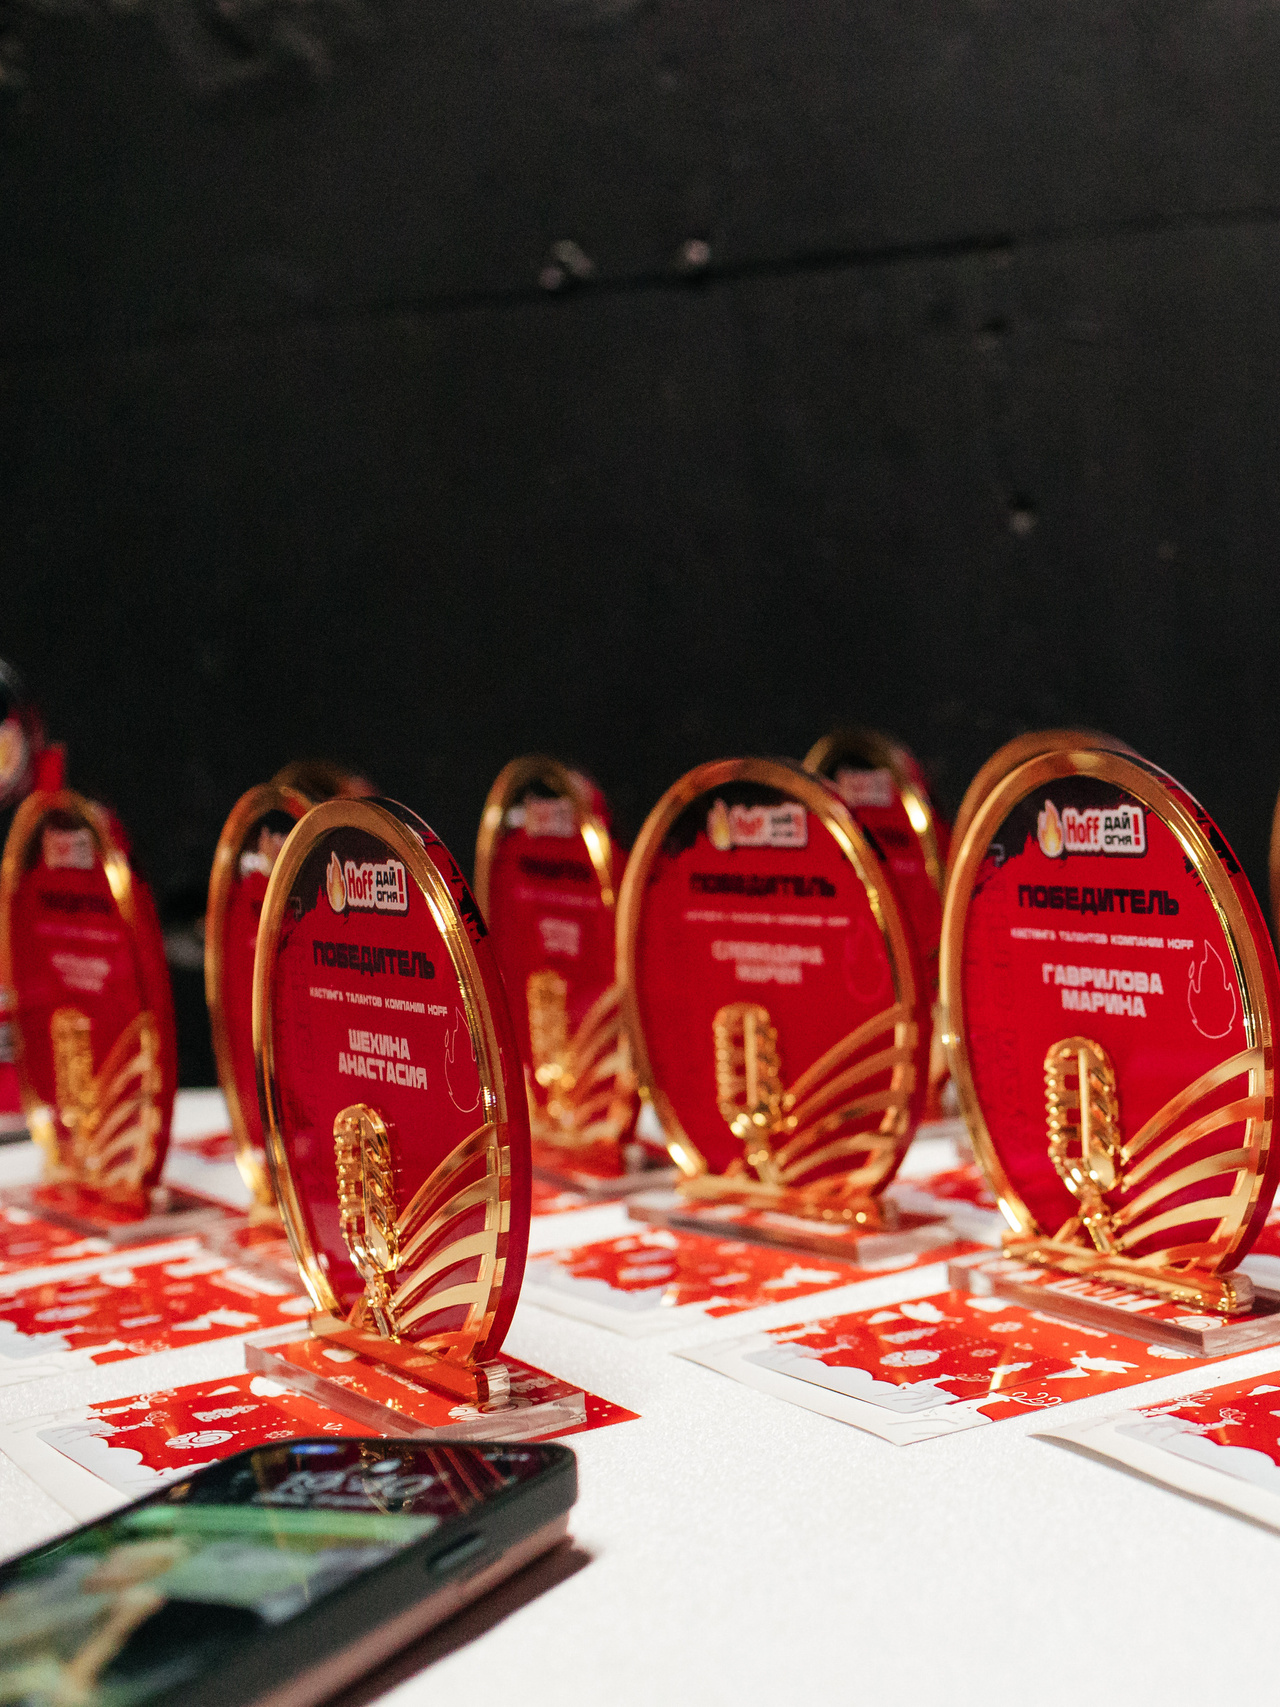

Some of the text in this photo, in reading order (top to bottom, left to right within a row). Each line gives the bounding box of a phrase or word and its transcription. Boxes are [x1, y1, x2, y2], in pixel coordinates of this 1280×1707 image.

[1065, 815, 1100, 844] Hoff
[1104, 811, 1131, 831] ДАЙ
[347, 868, 373, 900] Hoff
[376, 866, 397, 887] ДАЙ
[1018, 884, 1180, 916] ПОБЕДИТЕЛЬ
[313, 940, 436, 979] ПОБЕДИТЕЛЬ
[1042, 962, 1164, 995] ГАВРИЛОВА
[1060, 988, 1147, 1018] МАРИНА
[348, 1028, 411, 1060] ШЕХИНА
[338, 1052, 428, 1090] АНАСТАСИЯ
